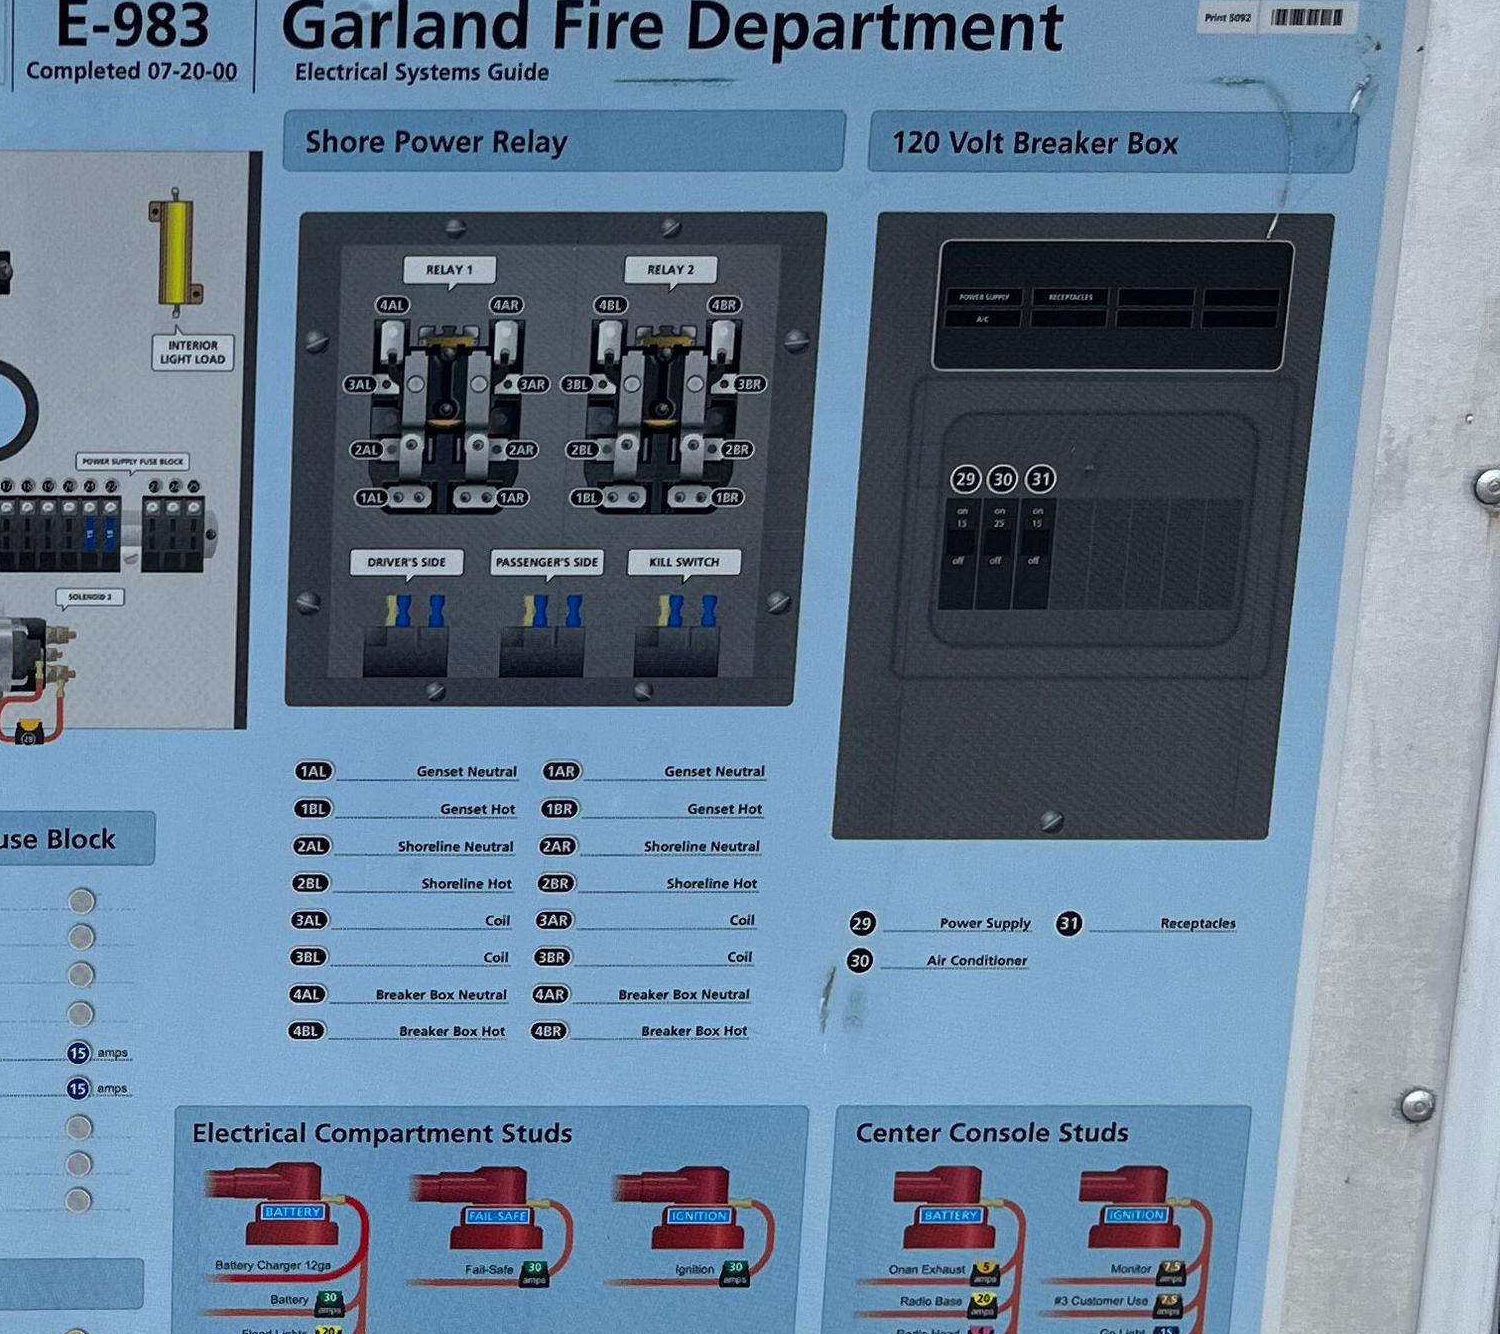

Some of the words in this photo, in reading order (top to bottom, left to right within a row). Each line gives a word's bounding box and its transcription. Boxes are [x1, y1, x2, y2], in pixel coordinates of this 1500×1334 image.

[1204, 13, 1227, 22] Print
[689, 0, 1064, 64] Department
[26, 60, 141, 85] Completed
[147, 61, 238, 82] 07-20-00
[295, 61, 388, 81] Electrical
[395, 62, 481, 86] Systems
[487, 61, 550, 82] Guide
[306, 128, 385, 154] Shore
[395, 129, 484, 154] Power
[493, 129, 567, 159] Relay
[893, 130, 940, 154] 120
[948, 129, 1005, 155] Volt
[1013, 129, 1119, 155] Breaker
[1127, 131, 1179, 155] Box
[426, 264, 464, 276] RELAY
[467, 264, 473, 275] 1
[647, 264, 685, 275] RELAY
[687, 264, 695, 275] 2
[711, 299, 736, 311] 4BR
[168, 340, 218, 351] INTERIOR
[160, 354, 191, 365] LIGHT
[194, 354, 226, 365] LOAD
[349, 379, 372, 390] 3AL
[956, 472, 976, 486] 29
[993, 472, 1013, 487] 30
[1031, 472, 1050, 486] 31
[367, 557, 419, 568] DRIVER'S
[421, 557, 446, 568] SIDE
[496, 557, 571, 568] PASSENGER'S
[573, 557, 599, 568] SIDE
[649, 557, 673, 568] KILL
[675, 557, 720, 568] SWITCH
[47, 827, 116, 850] Block
[297, 840, 325, 853] 2AL
[398, 840, 461, 853] Shoreline
[464, 840, 514, 853] Neutral
[851, 917, 872, 931] 29
[940, 917, 983, 929] Power
[986, 917, 1032, 933] Supply
[1059, 916, 1078, 930] 31
[1161, 917, 1236, 933] Receptacles
[71, 1047, 86, 1060] 15
[97, 1049, 129, 1062] amps
[193, 1121, 306, 1144] Electrical
[315, 1123, 493, 1148] Compartment
[502, 1122, 572, 1144] Studs
[856, 1122, 942, 1144] Center
[949, 1121, 1050, 1143] Console
[1058, 1121, 1129, 1143] Studs
[265, 1207, 320, 1217] BATTERY
[672, 1211, 726, 1221] IGNITION
[925, 1210, 977, 1221] BATTERY
[900, 1296, 933, 1307] Radio
[934, 1296, 963, 1307] Base
